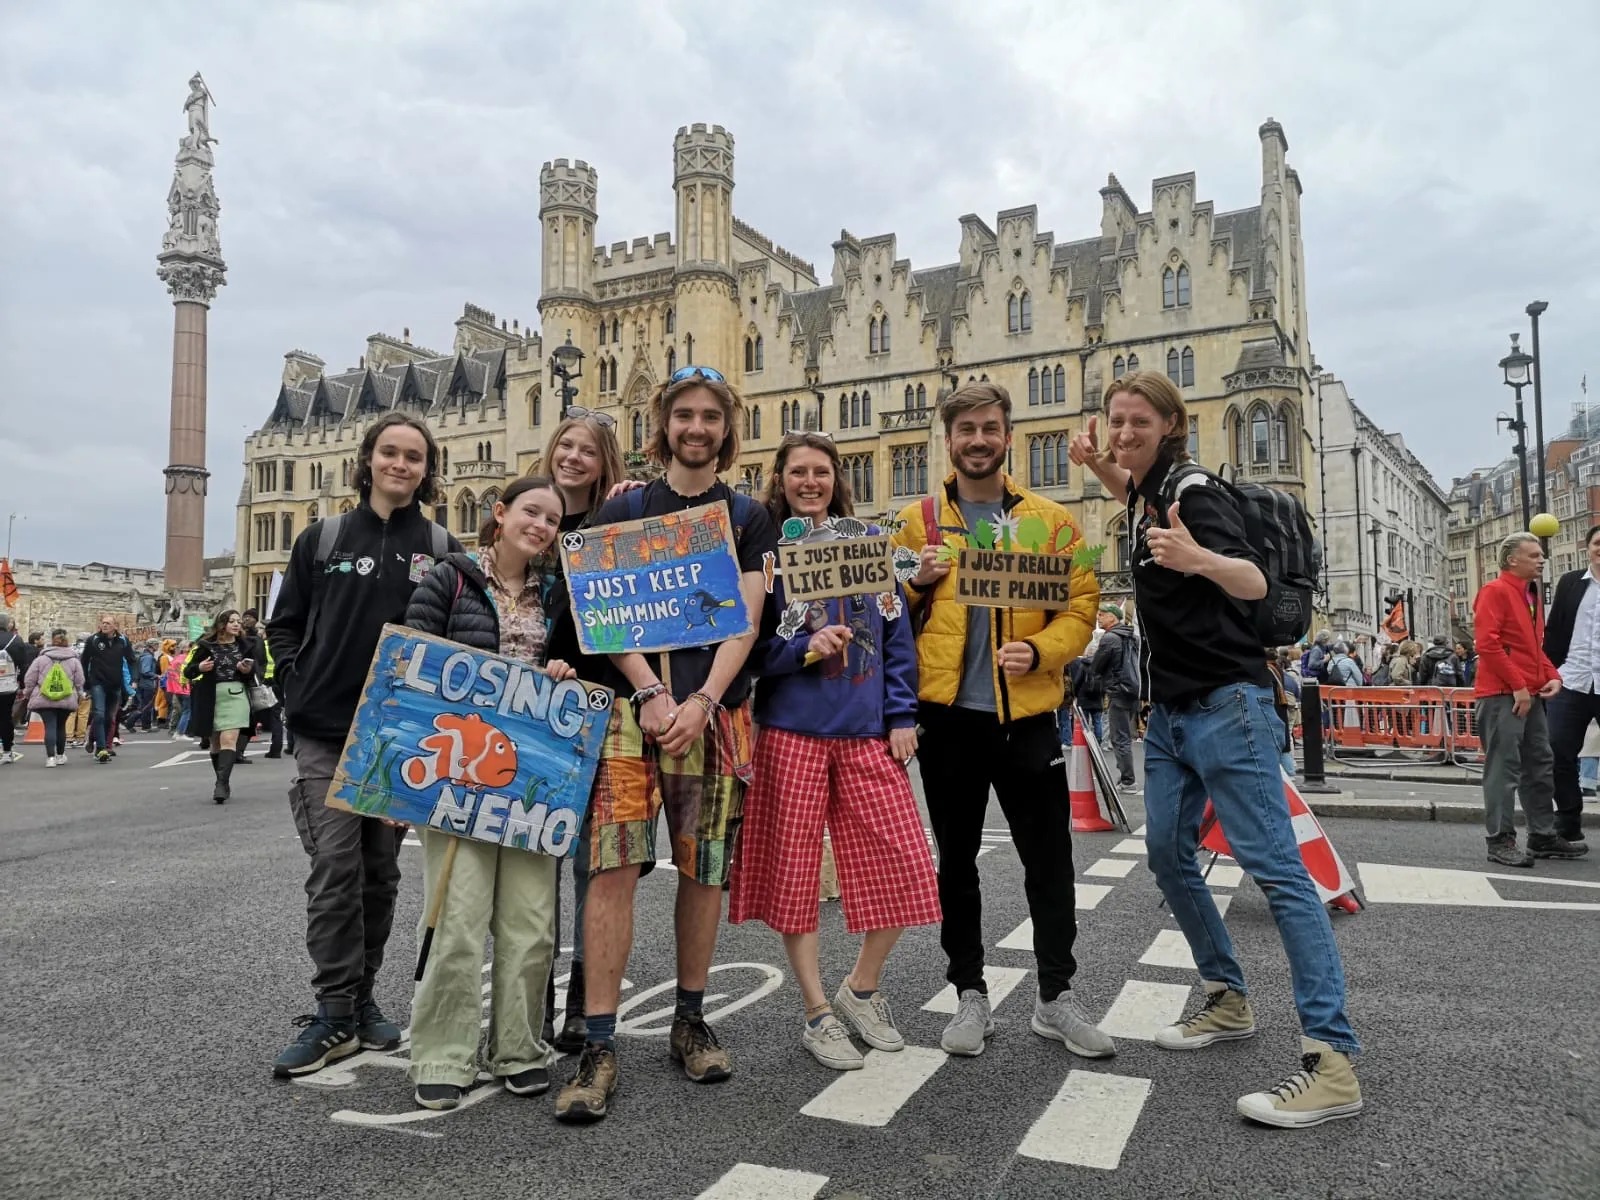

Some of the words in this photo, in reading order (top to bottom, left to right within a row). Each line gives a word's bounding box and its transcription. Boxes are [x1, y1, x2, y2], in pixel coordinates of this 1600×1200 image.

[786, 551, 799, 567] I
[804, 546, 840, 566] JUST
[843, 540, 888, 561] REALLY
[960, 551, 967, 569] I
[971, 552, 1015, 572] JUST
[1018, 555, 1073, 576] REALLY
[583, 573, 637, 601] JUST
[649, 563, 703, 593] KEEP
[788, 567, 834, 594] LIKE
[839, 561, 889, 588] BUGS
[959, 578, 1000, 598] LIKE
[1008, 580, 1069, 602] PLANTS
[584, 598, 681, 628] SWIMMING
[631, 624, 646, 647] ?
[402, 642, 589, 739] LOSING
[427, 785, 581, 858] NEMO
